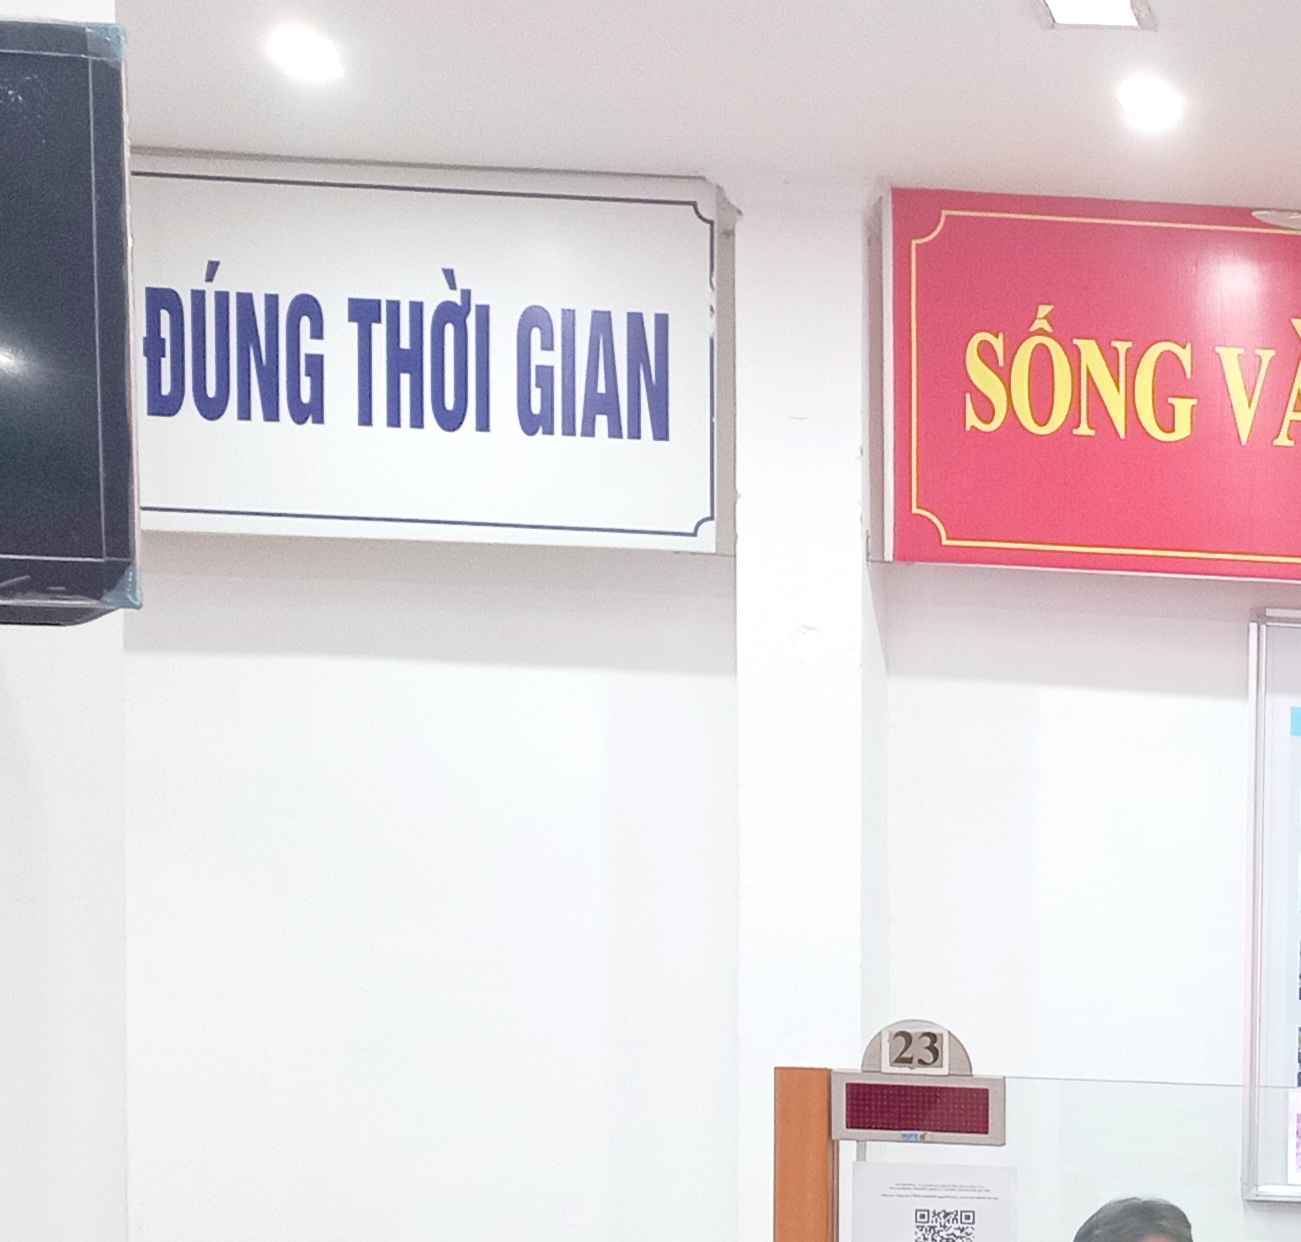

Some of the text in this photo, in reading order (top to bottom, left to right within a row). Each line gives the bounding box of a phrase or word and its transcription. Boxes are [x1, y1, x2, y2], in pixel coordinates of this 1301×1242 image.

[143, 260, 670, 442] ĐÚNG THỜI GIAN
[964, 304, 1198, 443] SỐNG
[892, 1030, 940, 1066] 23
